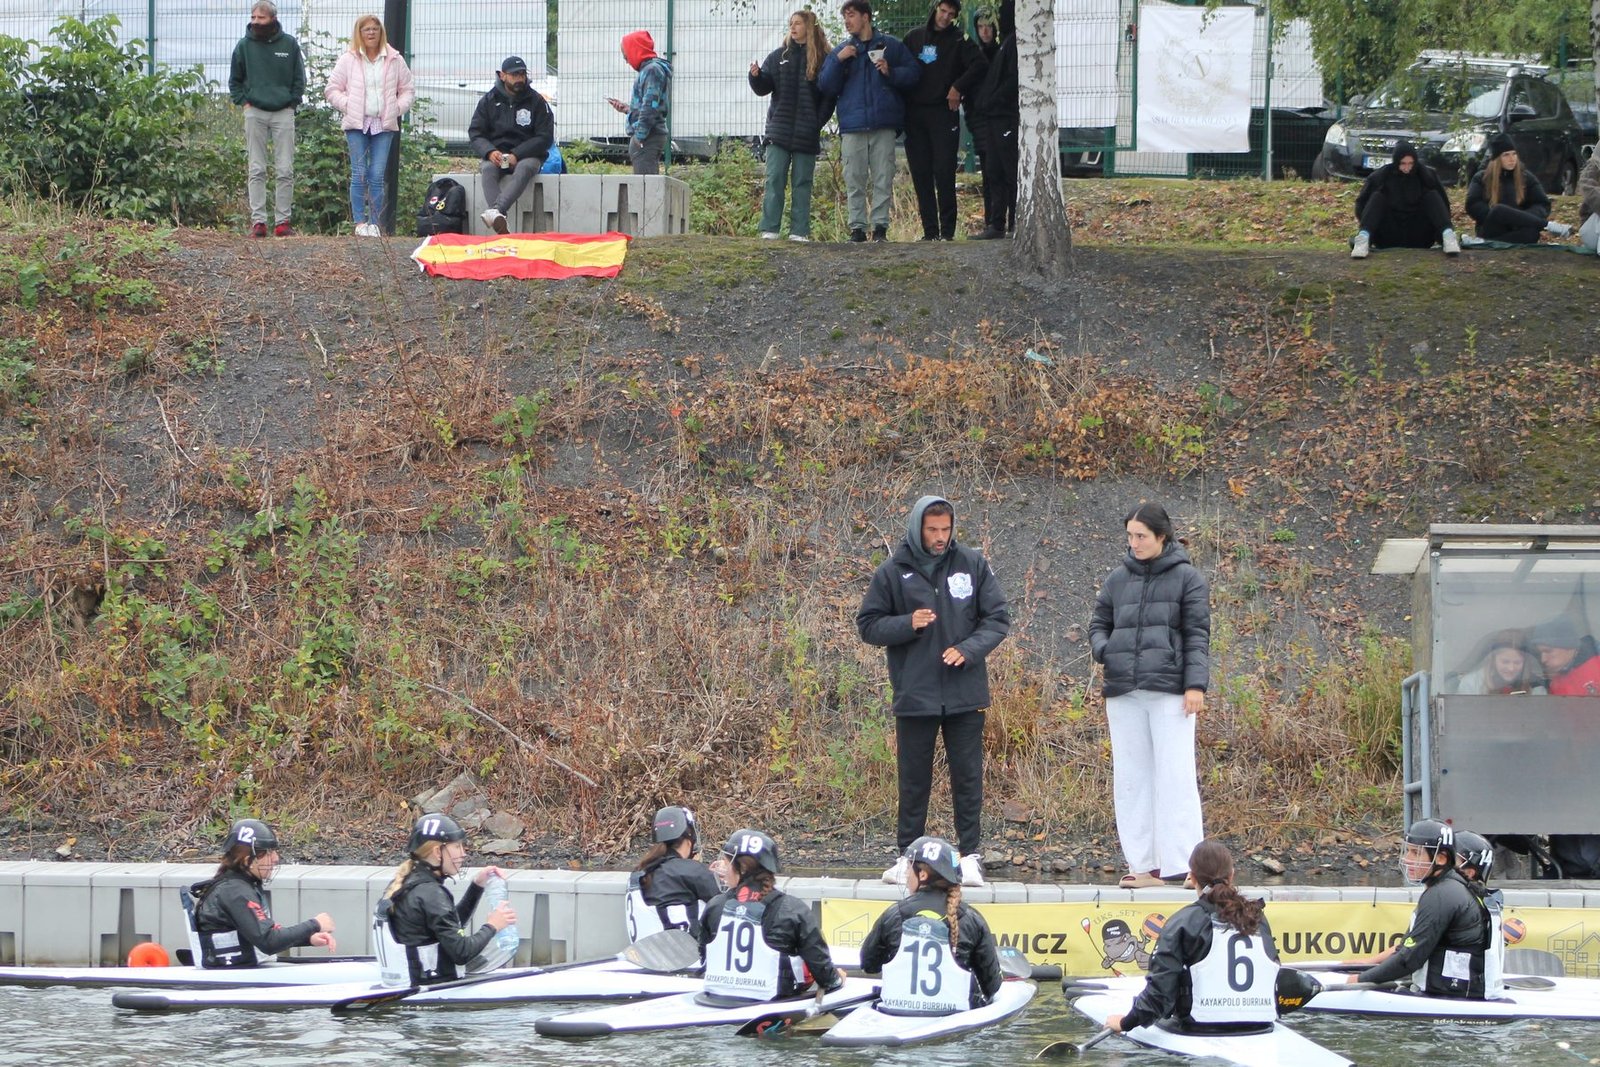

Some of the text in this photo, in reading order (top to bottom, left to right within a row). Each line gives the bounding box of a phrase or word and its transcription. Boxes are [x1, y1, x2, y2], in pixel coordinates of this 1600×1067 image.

[238, 826, 255, 843] 12
[422, 819, 440, 835] 17
[1441, 827, 1453, 845] 11
[740, 835, 763, 854] 19
[922, 842, 942, 861] 13
[1479, 849, 1493, 866] 14
[1094, 911, 1113, 925] UKS
[721, 920, 755, 973] 19
[1273, 932, 1405, 954] UKOWIC
[903, 940, 943, 997] 13
[1227, 933, 1254, 992] 6
[1200, 997, 1241, 1007] KAYAKPOLO
[1242, 997, 1272, 1007] BURRIANA
